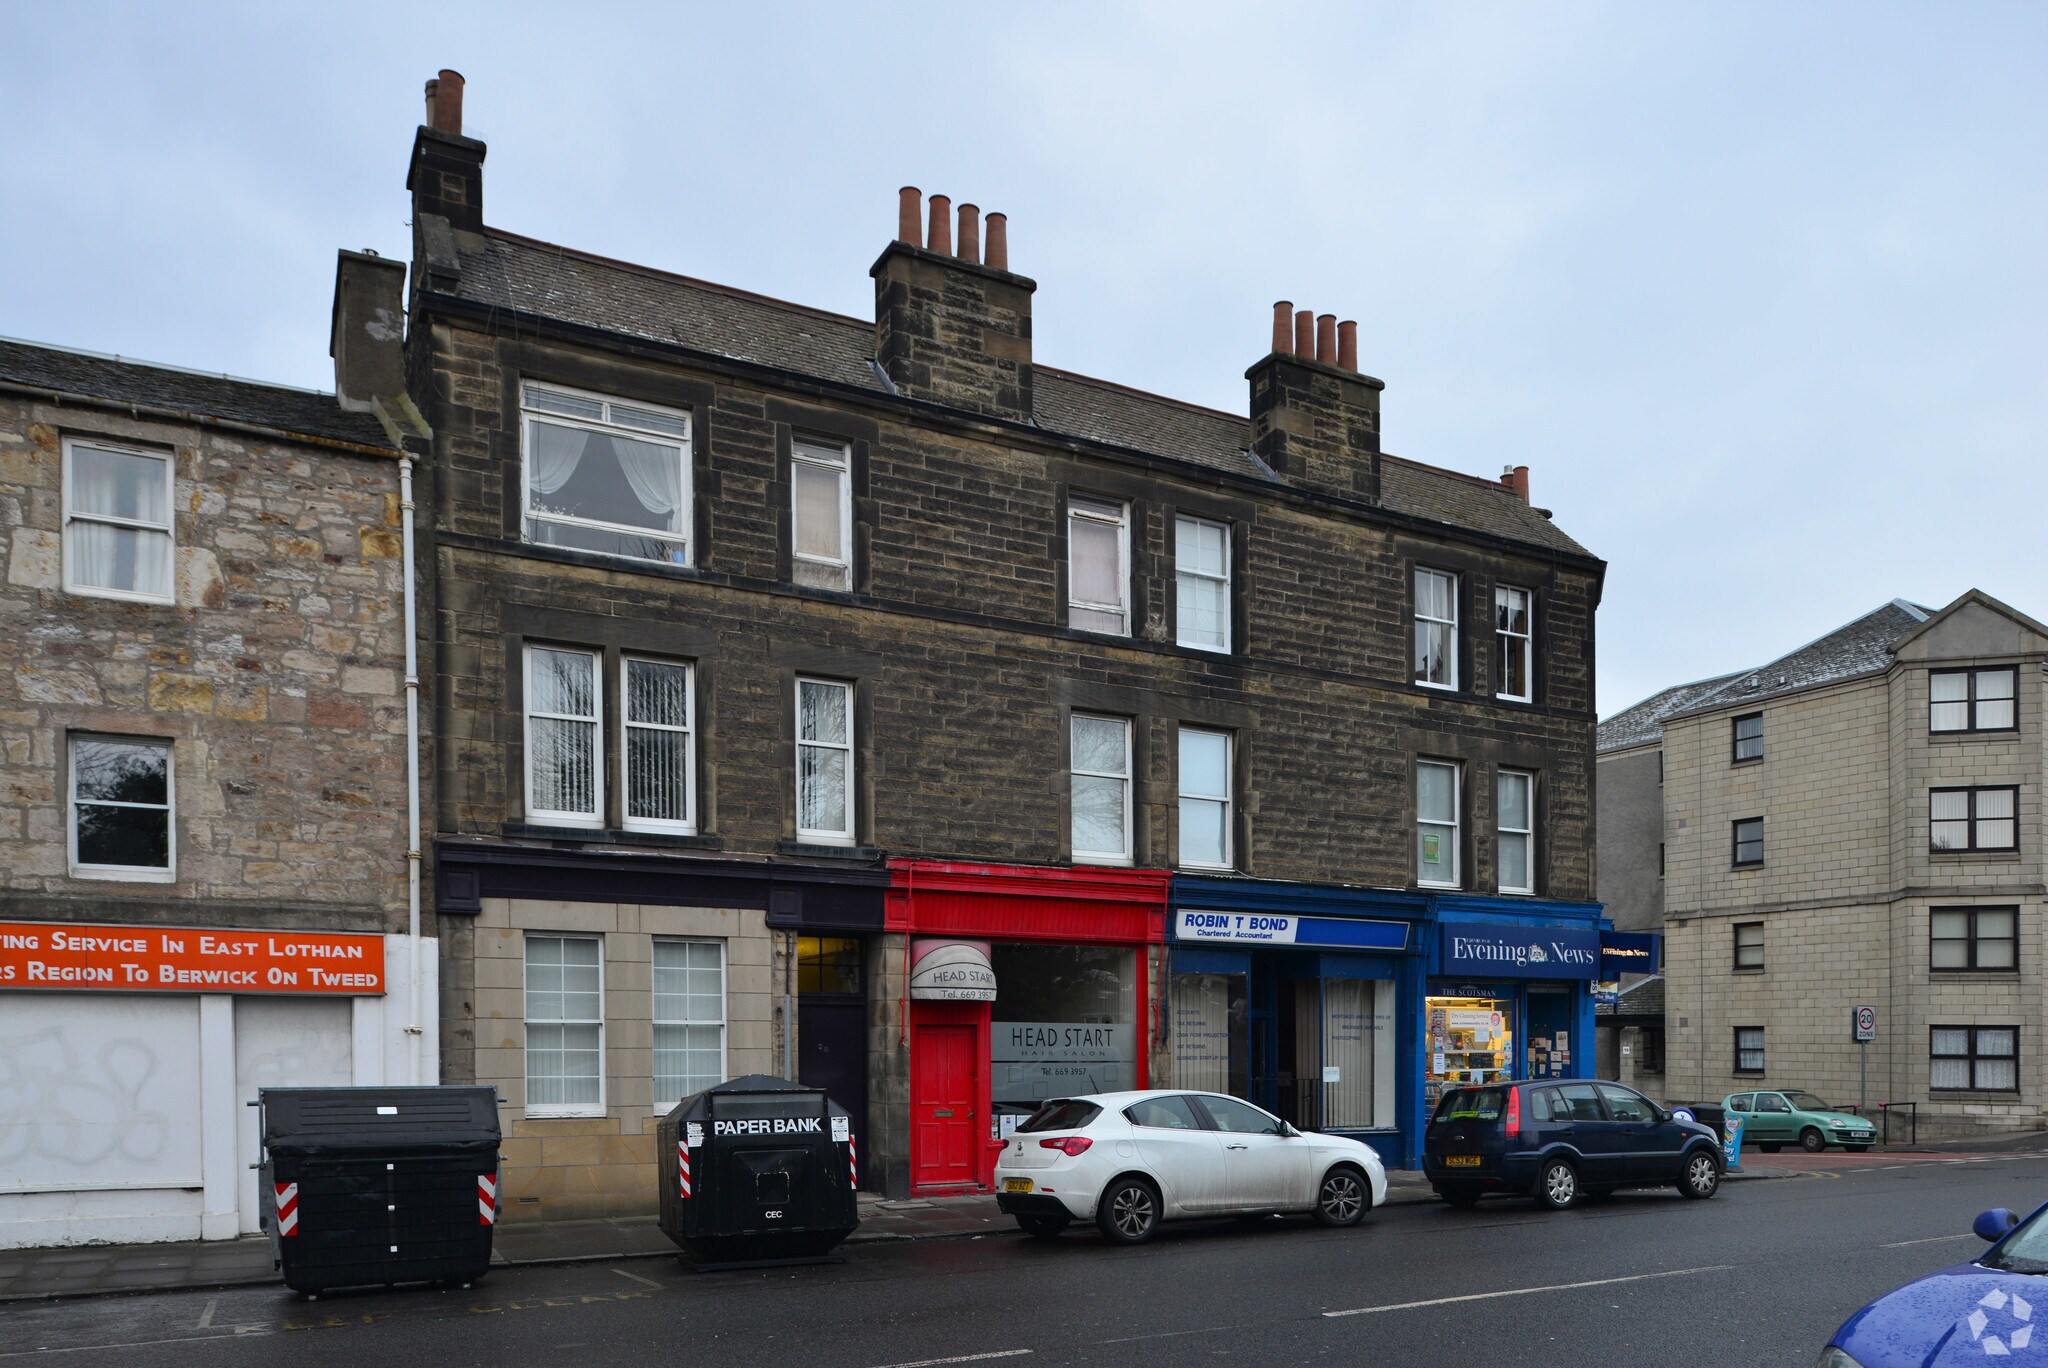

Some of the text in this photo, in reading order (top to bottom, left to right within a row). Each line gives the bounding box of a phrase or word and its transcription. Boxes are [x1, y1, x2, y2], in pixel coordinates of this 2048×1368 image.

[1185, 914, 1288, 930] ROBIN T BOND
[1197, 929, 1273, 939] Chartered Accountant
[0, 934, 39, 949] ING
[1453, 936, 1594, 966] Evening News
[1603, 948, 1626, 957] Evening
[0, 965, 15, 980] S
[933, 971, 993, 984] HEAD START
[941, 990, 992, 999] Tel. 669 3957
[1458, 989, 1496, 997] SCOTSMAN
[1861, 1014, 1872, 1023] 20
[1012, 1027, 1113, 1047] HEAD START
[1055, 1067, 1068, 1075] 669
[1070, 1068, 1087, 1076] 3957
[714, 1120, 770, 1135] PAPER
[774, 1117, 822, 1133] BANK
[765, 1210, 783, 1219] CEC
